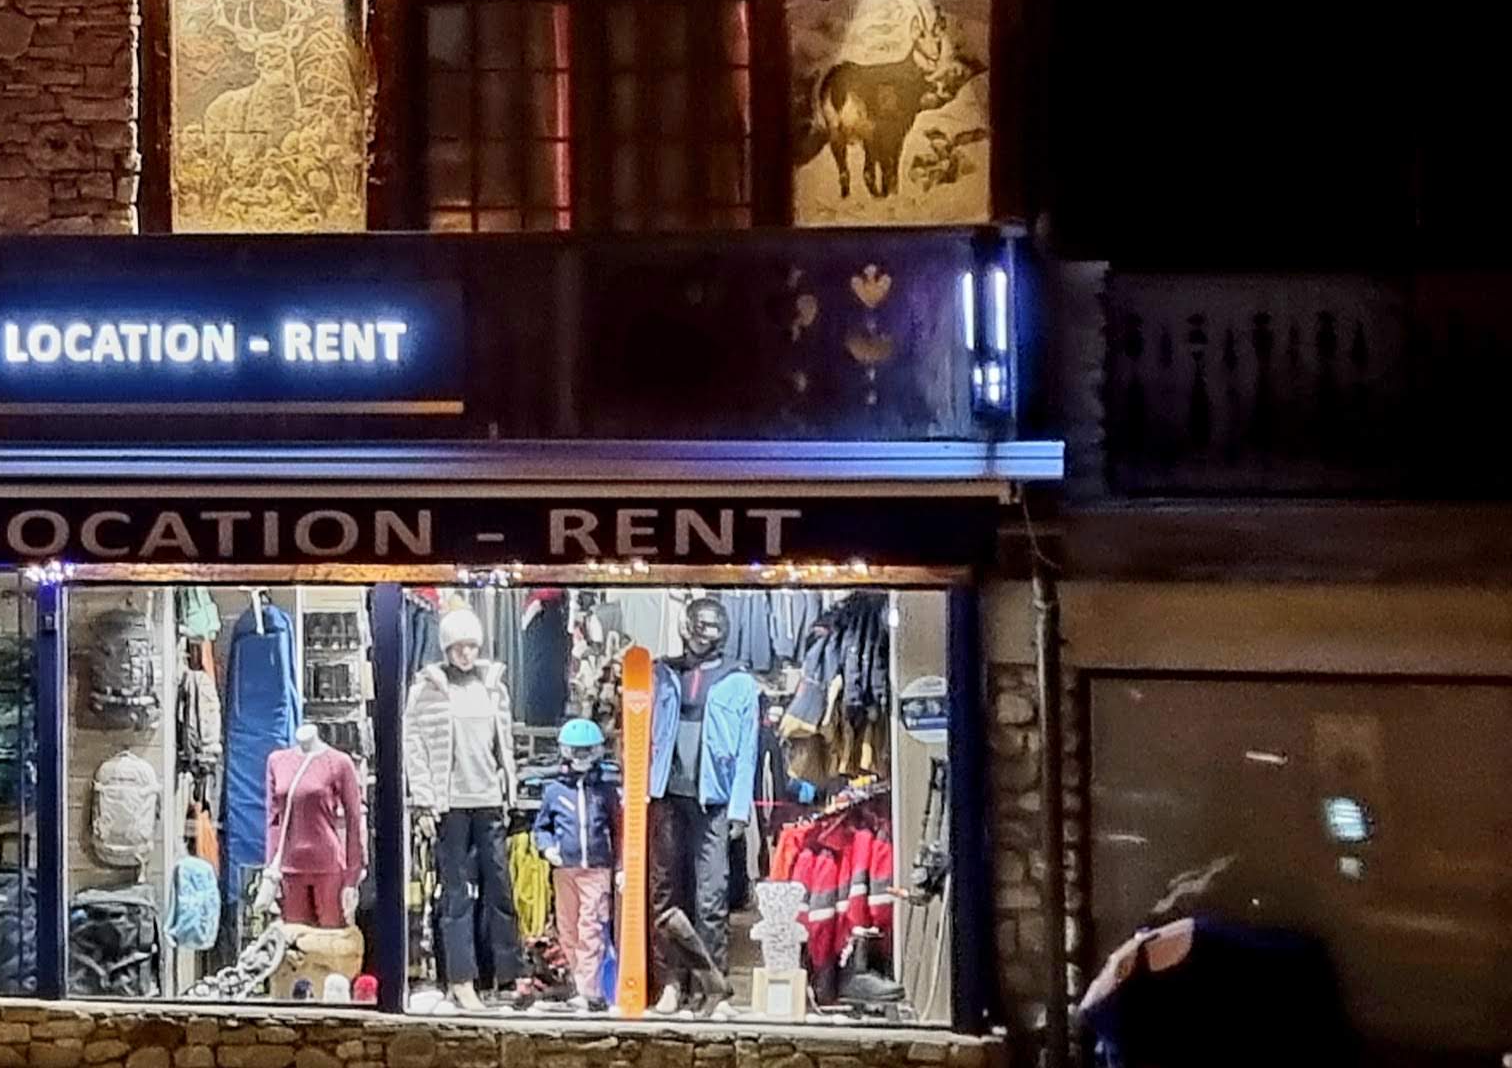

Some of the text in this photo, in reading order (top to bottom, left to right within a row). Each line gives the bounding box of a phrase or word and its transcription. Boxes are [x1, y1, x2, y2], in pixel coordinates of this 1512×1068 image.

[4, 322, 236, 363] LOCATION
[284, 322, 407, 362] RENT
[548, 508, 803, 556] RENT
